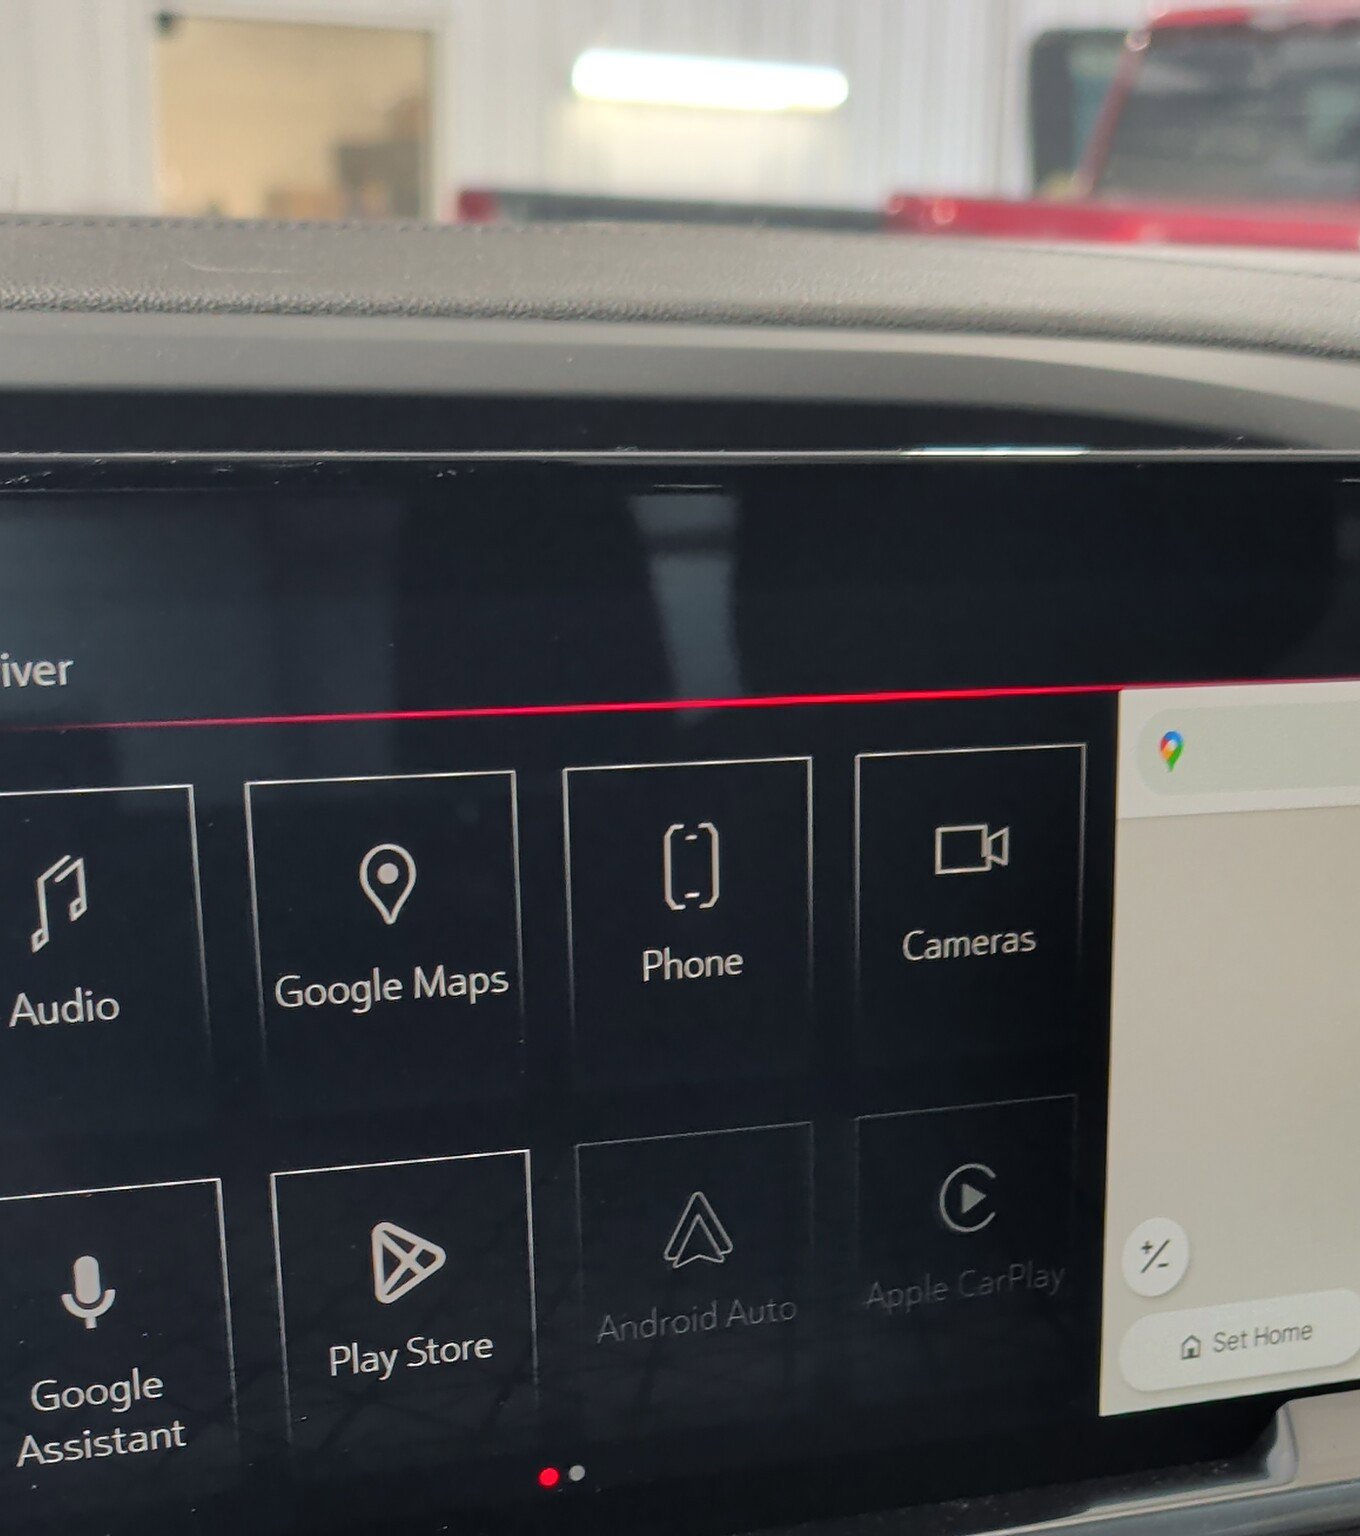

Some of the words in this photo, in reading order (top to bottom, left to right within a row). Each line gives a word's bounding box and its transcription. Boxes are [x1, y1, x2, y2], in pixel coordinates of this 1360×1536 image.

[642, 947, 744, 984] Phone
[902, 927, 1037, 963] Cameras
[9, 988, 120, 1028] Audio
[274, 970, 404, 1014] Google
[413, 964, 510, 1003] Maps
[864, 1272, 949, 1315] Apple
[956, 1259, 1066, 1300] CarPlay
[596, 1299, 718, 1343] Android
[725, 1297, 798, 1329] Auto
[1212, 1329, 1248, 1354] Set
[1253, 1321, 1314, 1349] Home
[329, 1342, 399, 1381] Play
[405, 1334, 494, 1369] Store
[30, 1367, 164, 1413] Google
[16, 1420, 187, 1468] Assistant
